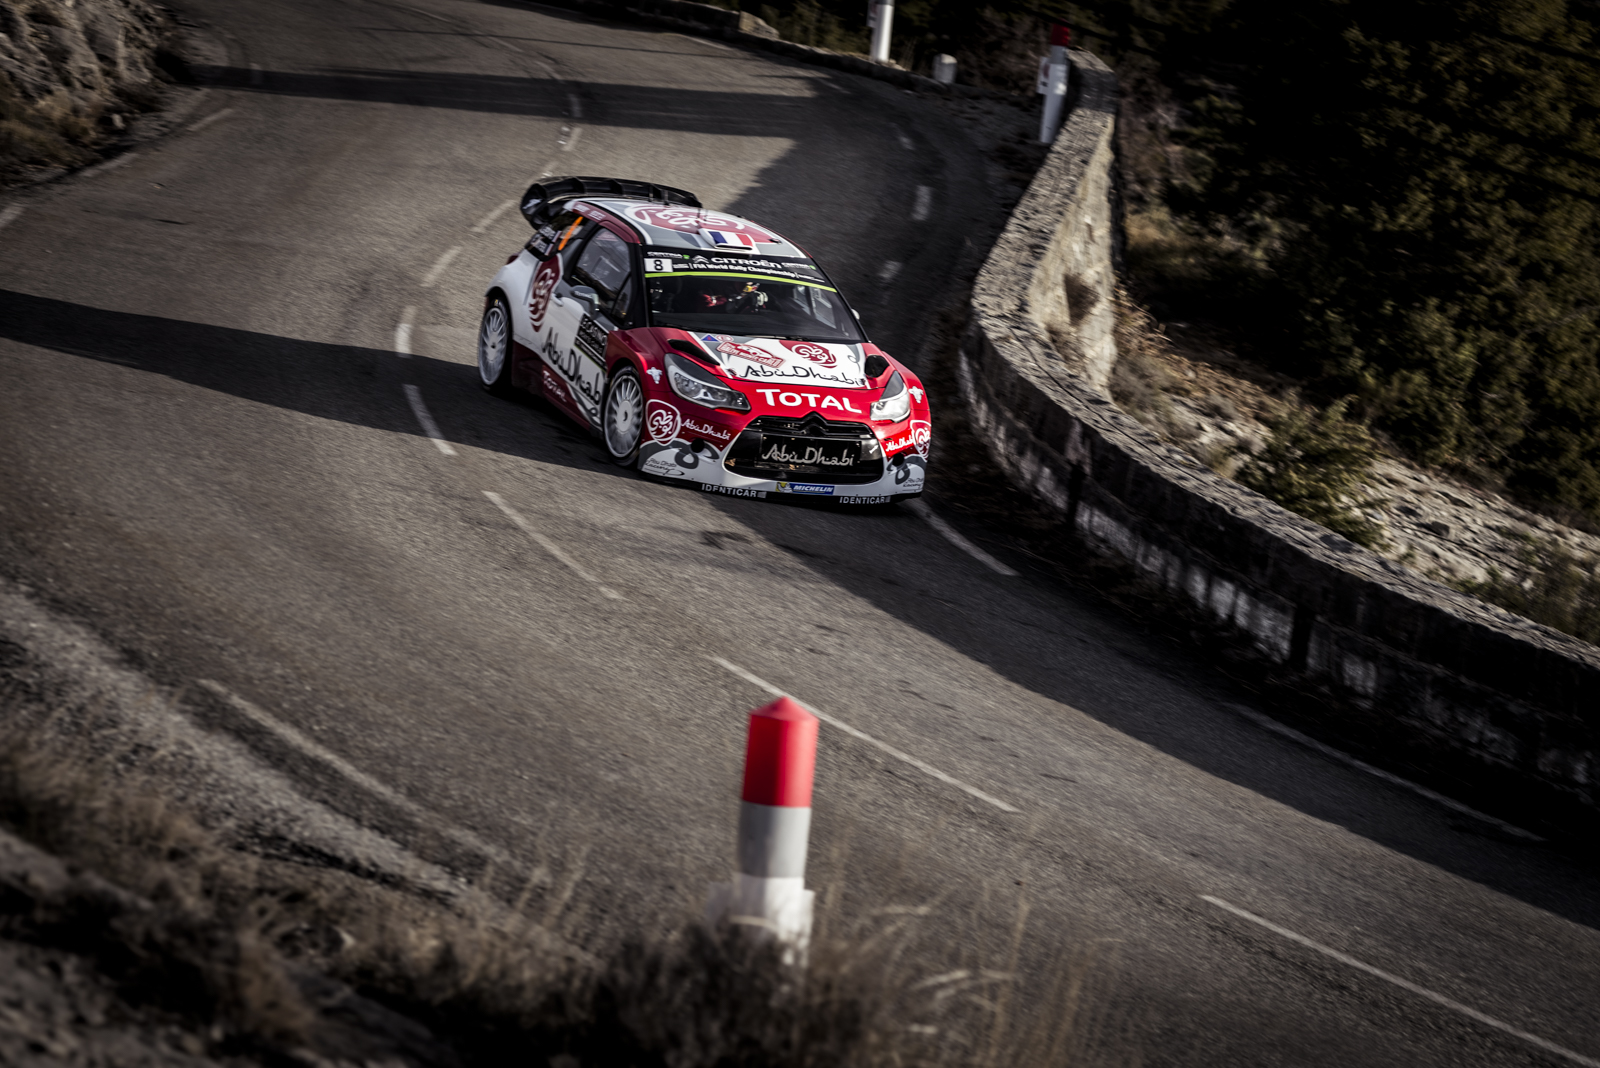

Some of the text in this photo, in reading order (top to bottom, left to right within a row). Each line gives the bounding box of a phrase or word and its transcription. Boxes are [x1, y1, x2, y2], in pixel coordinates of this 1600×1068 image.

[653, 259, 663, 271] 8
[755, 388, 862, 413] TOTAL
[701, 483, 757, 498] IDENTICAR
[793, 485, 834, 493] MICHELIN
[839, 496, 885, 505] IDENTICAR
